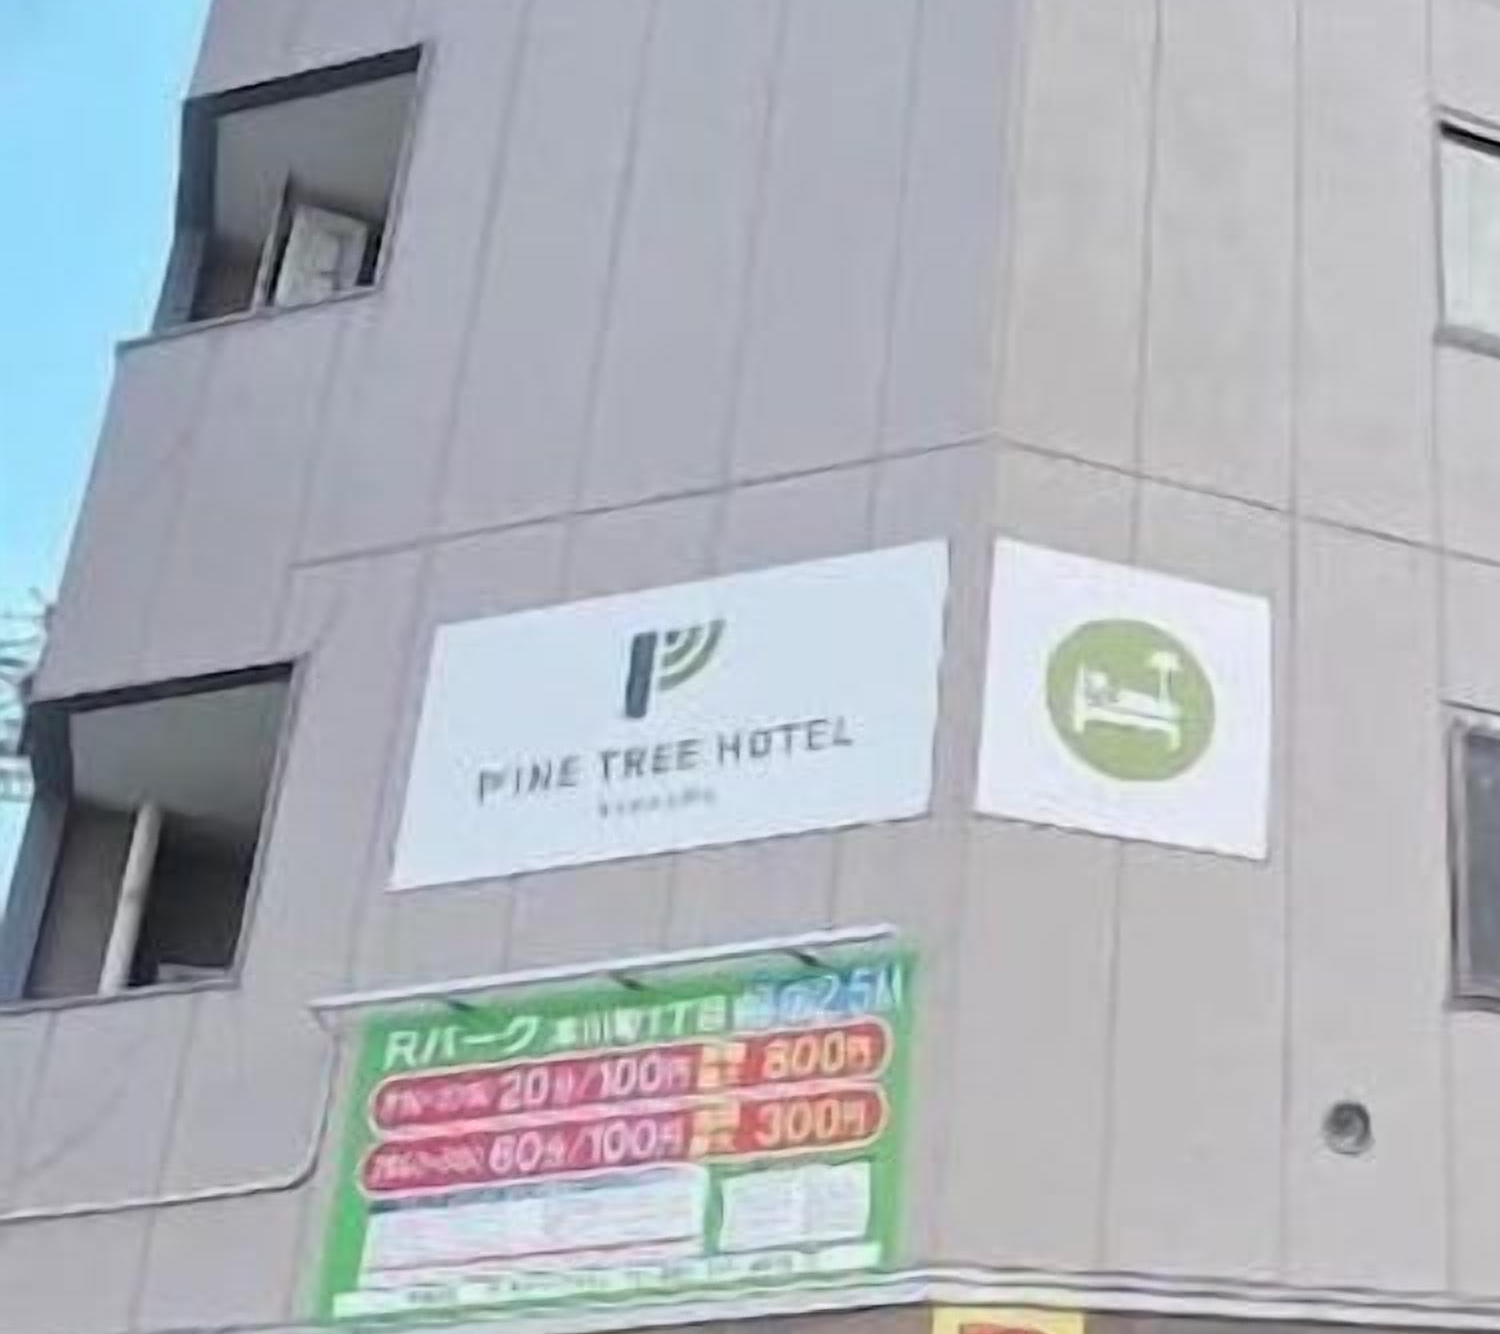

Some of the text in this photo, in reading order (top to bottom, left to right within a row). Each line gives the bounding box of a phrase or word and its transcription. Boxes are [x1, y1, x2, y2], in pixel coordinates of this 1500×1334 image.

[478, 754, 581, 805] PINE
[599, 738, 702, 782] TREE
[716, 717, 855, 765] HOTEL
